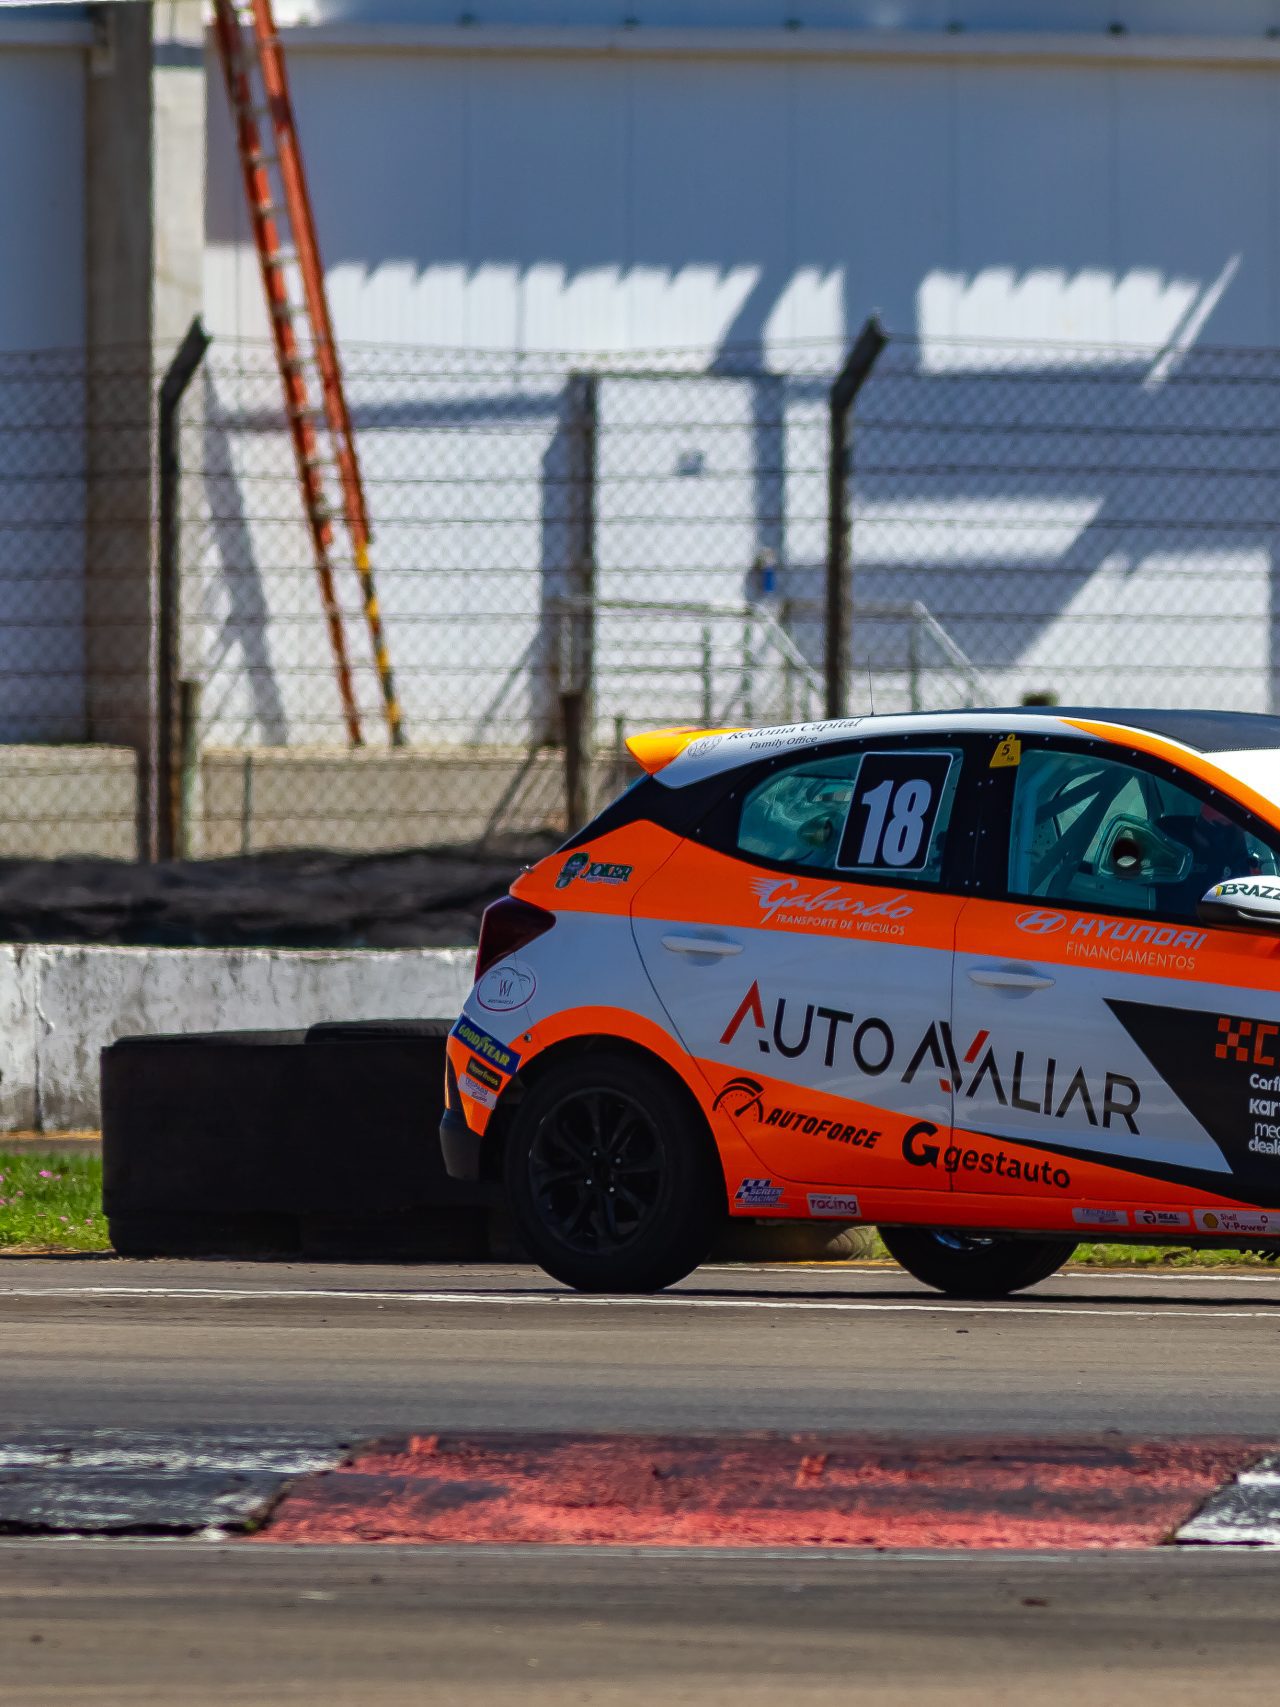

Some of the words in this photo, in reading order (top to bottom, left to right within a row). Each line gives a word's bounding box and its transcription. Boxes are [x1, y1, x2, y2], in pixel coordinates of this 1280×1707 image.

[800, 718, 864, 733] Capital
[750, 738, 787, 750] Family
[786, 736, 818, 746] Office
[858, 779, 932, 866] 18
[750, 876, 914, 924] Gabardo
[775, 913, 837, 929] TRANSPORTE
[839, 920, 853, 930] DE
[1070, 917, 1209, 950] HYUNDAI
[1066, 940, 1196, 971] FINANCIAMENTOS
[764, 1106, 882, 1149] AUTOFORCE
[942, 1147, 1071, 1189] gestauto
[810, 1197, 858, 1214] racing
[1220, 1213, 1237, 1221] Shell
[1222, 1220, 1267, 1232] V-Power
